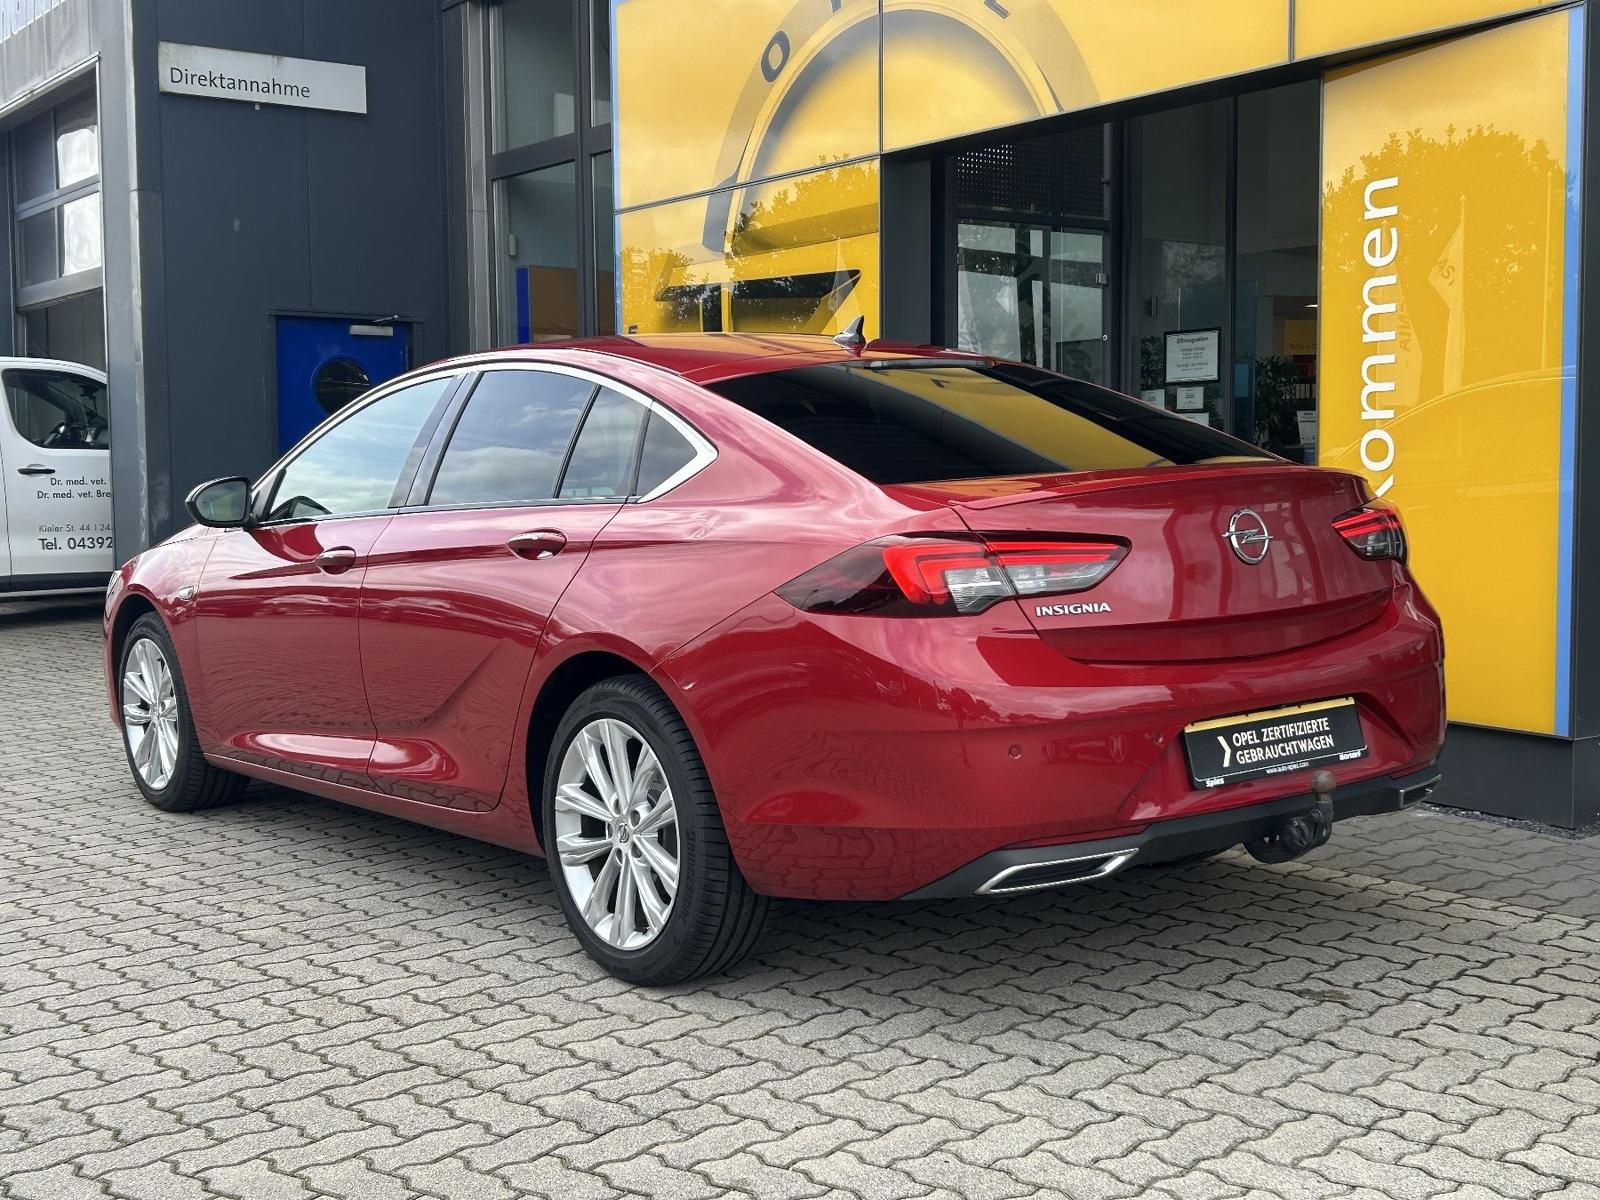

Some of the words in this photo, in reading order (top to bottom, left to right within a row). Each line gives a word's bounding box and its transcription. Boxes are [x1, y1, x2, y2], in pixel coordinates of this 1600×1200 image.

[170, 67, 311, 98] Direktannahme
[50, 477, 63, 486] Dr.
[37, 490, 50, 499] Dr.
[39, 524, 63, 533] Kieler
[38, 537, 62, 551] Tel.
[67, 537, 113, 550] 04392
[1035, 602, 1112, 617] INSIGNIA
[1232, 731, 1262, 747] OPEL
[1262, 717, 1331, 742] ZERTIFIZIERTE
[1235, 734, 1335, 765] GEBRAUCHTWAGEN
[1205, 777, 1225, 788] Spies
